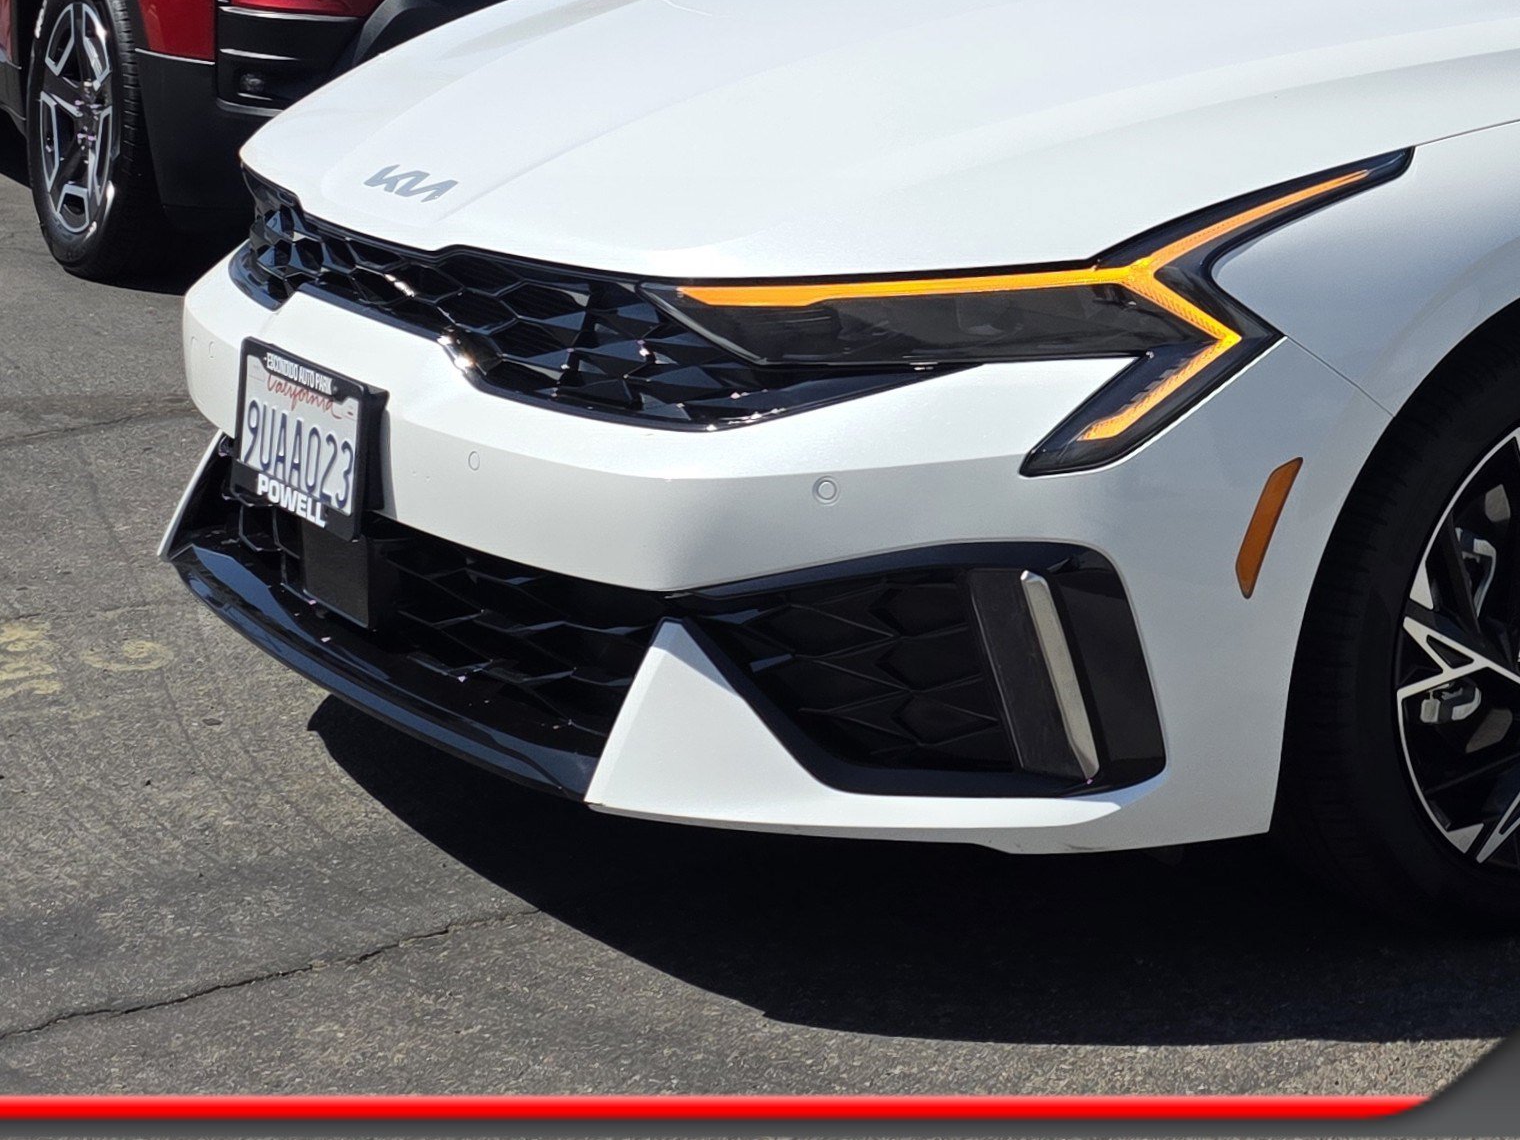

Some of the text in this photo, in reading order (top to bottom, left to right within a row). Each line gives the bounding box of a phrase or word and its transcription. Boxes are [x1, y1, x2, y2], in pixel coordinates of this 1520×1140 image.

[363, 163, 459, 203] KIA
[299, 366, 315, 389] AUTO
[315, 372, 333, 396] PARK
[243, 399, 355, 510] 9UAA023
[256, 473, 328, 529] POWELL
